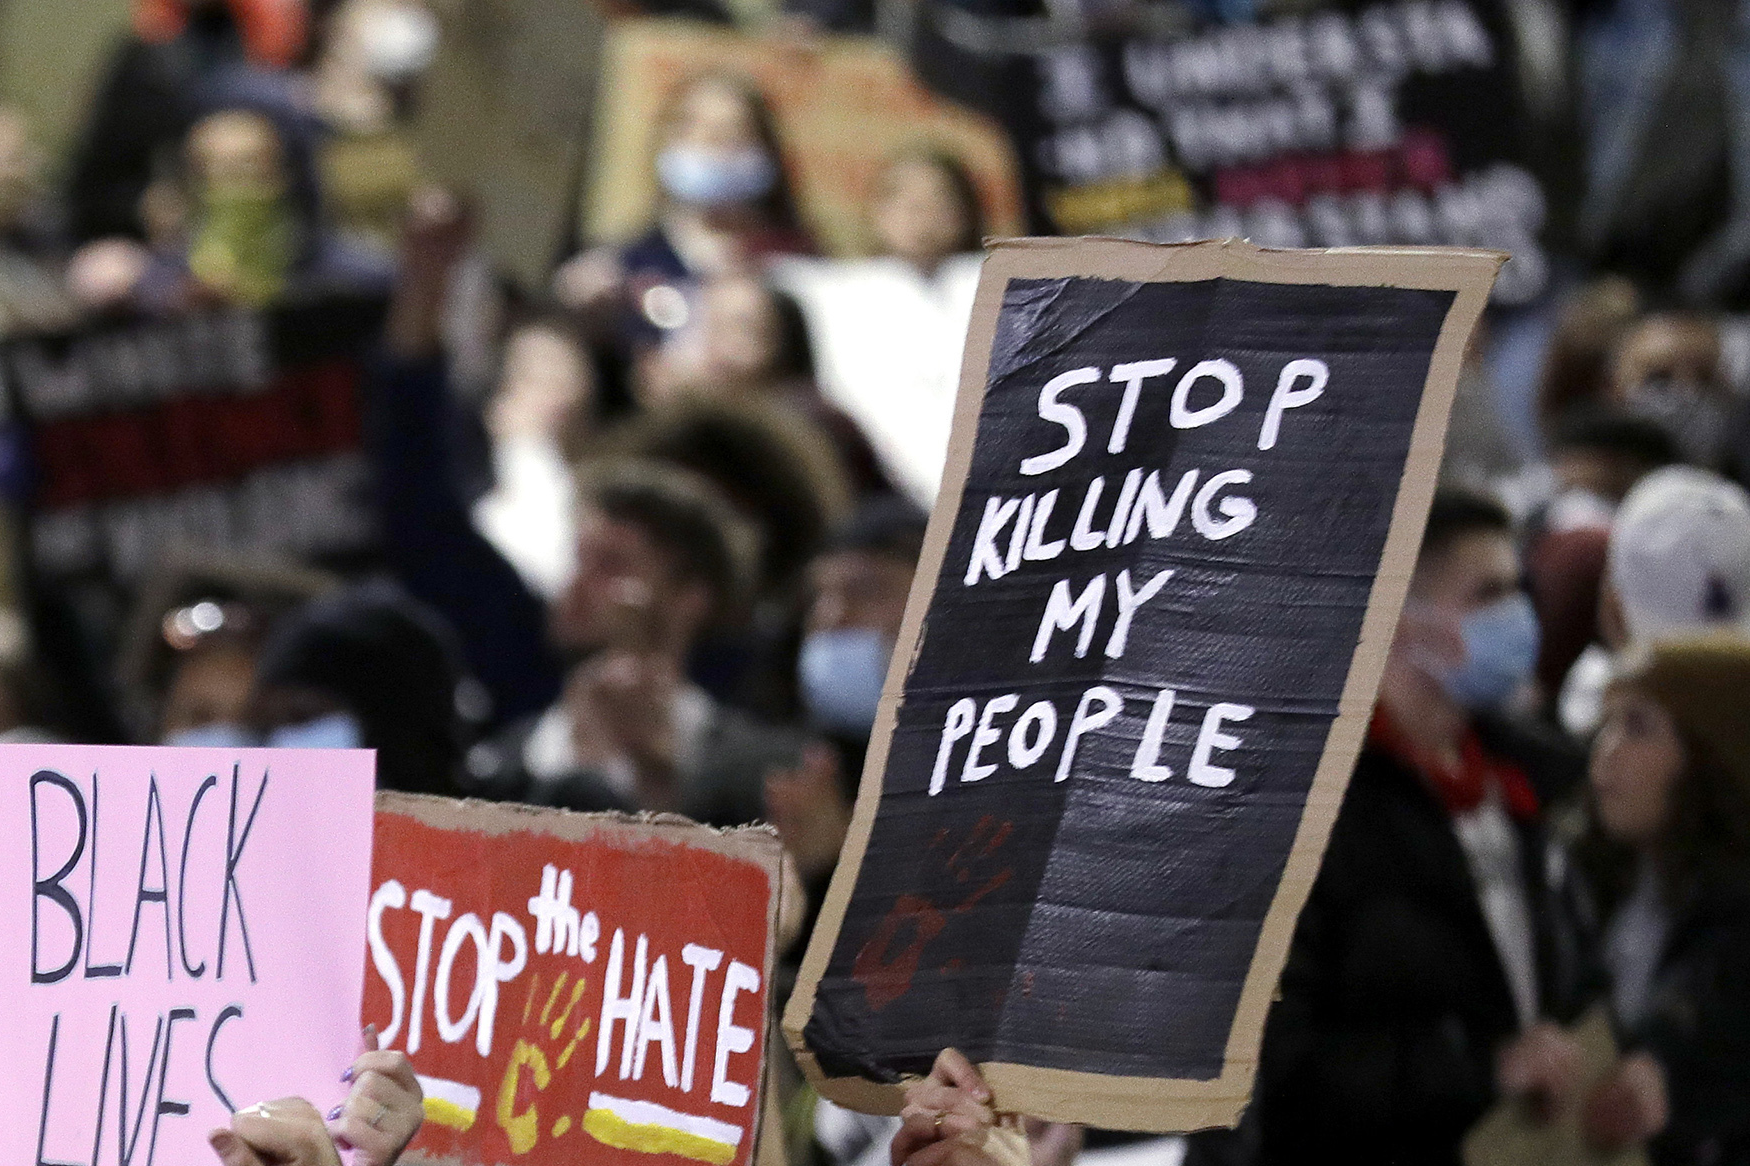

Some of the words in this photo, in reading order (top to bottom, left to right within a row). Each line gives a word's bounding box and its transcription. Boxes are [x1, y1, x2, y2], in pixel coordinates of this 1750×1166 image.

[1019, 358, 1331, 477] STOP
[963, 467, 1259, 588] KILLING
[1029, 568, 1176, 664] MY
[927, 685, 1256, 798] PEOPLE
[29, 763, 270, 985] BLACK
[366, 878, 527, 1056] STOP
[527, 862, 599, 962] the
[594, 926, 761, 1109] HATE
